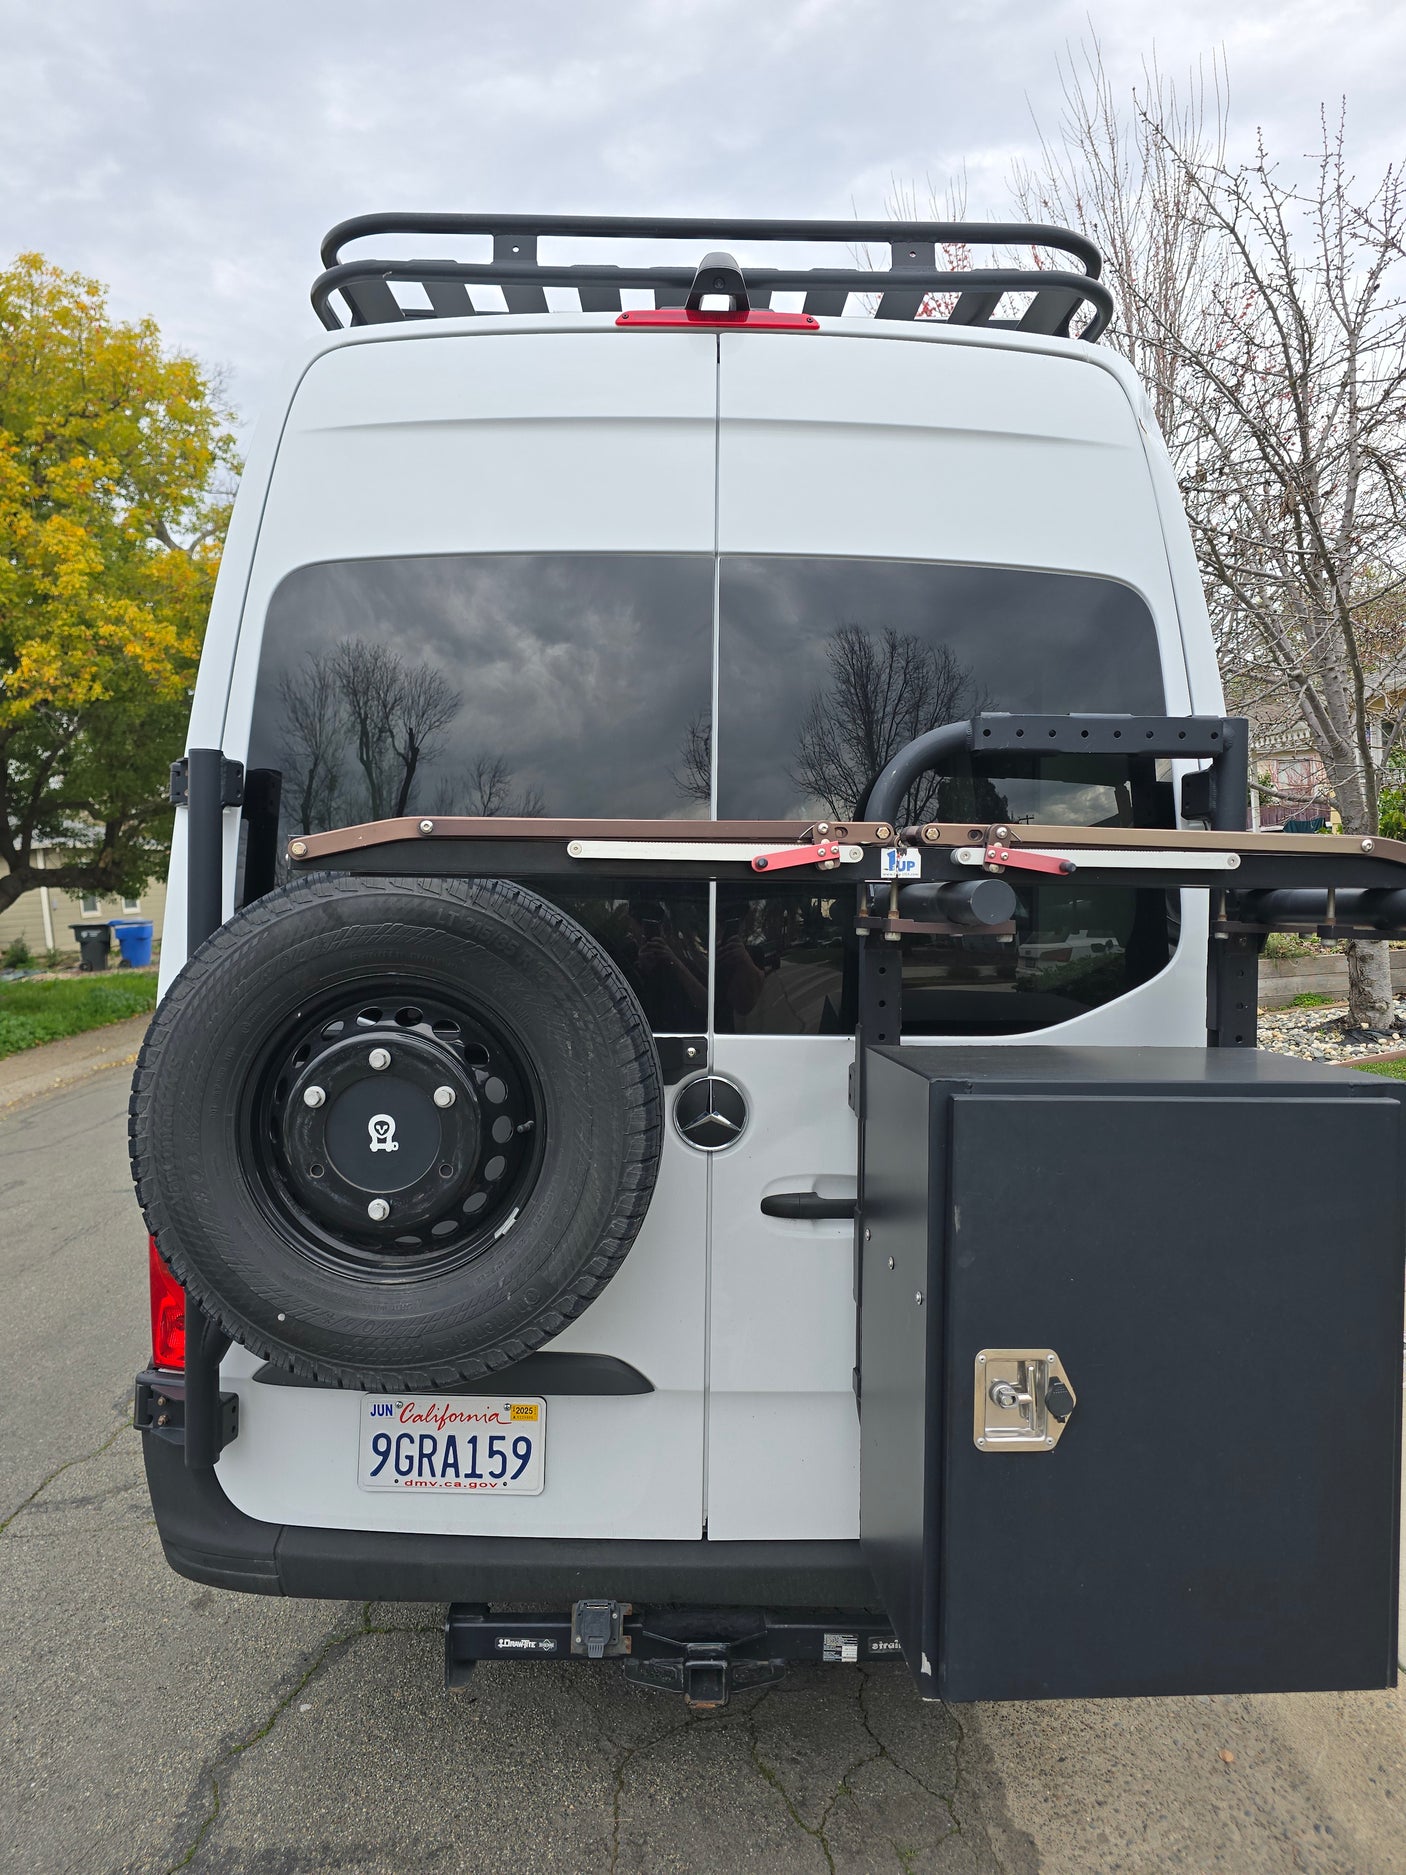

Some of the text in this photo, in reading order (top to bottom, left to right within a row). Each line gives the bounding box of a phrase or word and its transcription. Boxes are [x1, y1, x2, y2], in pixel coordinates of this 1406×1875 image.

[437, 908, 459, 926] LT
[370, 1404, 393, 1417] JUN
[399, 1401, 512, 1432] California
[515, 1406, 533, 1415] 2025
[370, 1432, 532, 1480] 9GRA159
[404, 1479, 498, 1489] dmv.ca.gov
